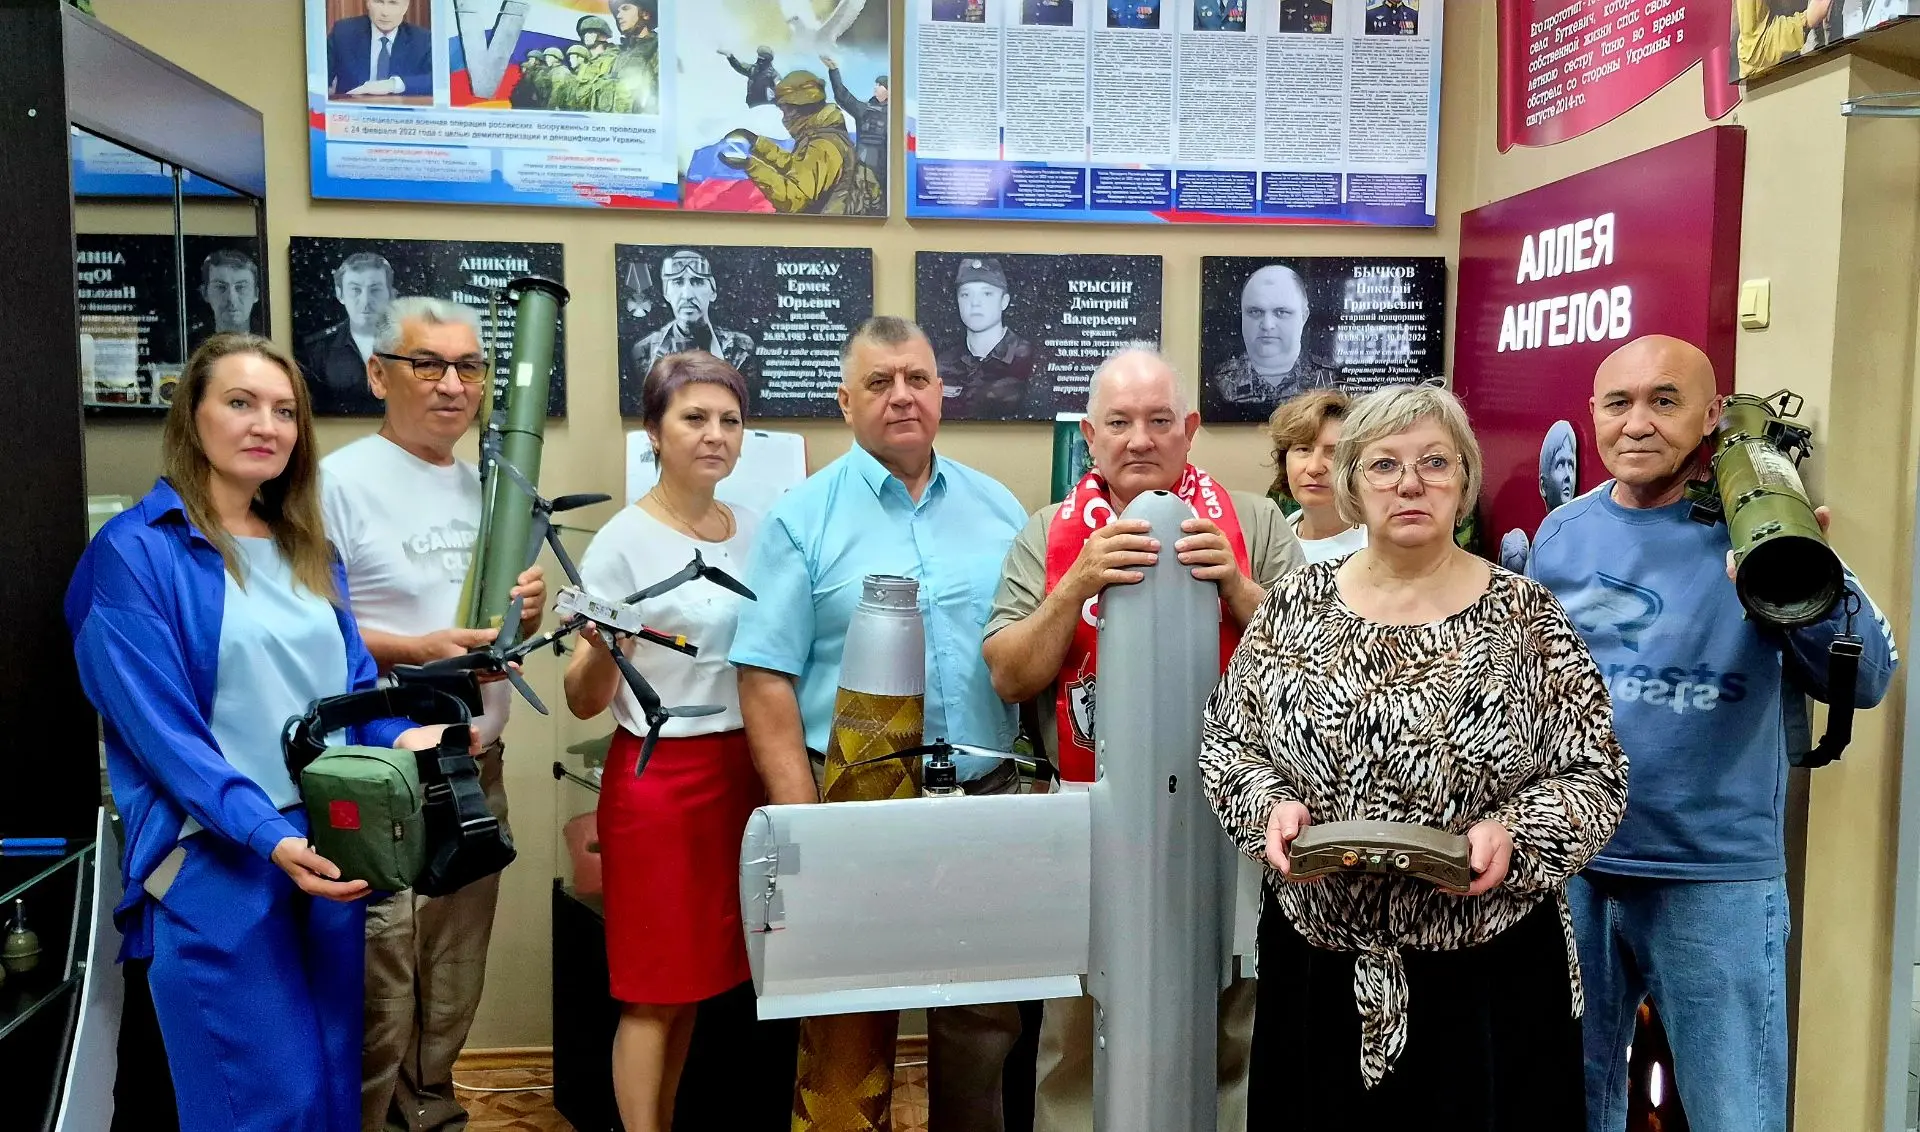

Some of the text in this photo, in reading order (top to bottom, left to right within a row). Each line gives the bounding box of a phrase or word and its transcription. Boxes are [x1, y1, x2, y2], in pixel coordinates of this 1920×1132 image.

[1530, 22, 1543, 37] Его
[1530, 36, 1548, 55] села
[1555, 12, 1596, 43] Буткевич,
[1528, 36, 1580, 73] собственной
[1583, 22, 1612, 46] жизни
[1616, 9, 1640, 30] спас
[1528, 7, 1685, 92] летнюю сестру Таню во время
[1527, 83, 1563, 109] обстрела
[1566, 78, 1577, 91] со
[1582, 58, 1620, 84] стороны
[1626, 35, 1671, 64] Украины
[1526, 106, 1556, 126] августе
[362, 117, 414, 125] специальная
[449, 120, 486, 128] операция
[536, 124, 590, 132] вооруженных
[610, 127, 656, 135] проводимая
[350, 126, 360, 134] 24
[362, 127, 398, 136] февраля
[399, 128, 416, 136] 2022
[472, 132, 540, 140] демилитаризации
[550, 134, 610, 143] денацификации
[1516, 212, 1615, 285] АЛЛЕЯ
[458, 257, 529, 272] АНИКИН
[776, 263, 840, 276] КОРЖАУ
[1353, 266, 1415, 278] БЫЧКОВ
[787, 280, 830, 294] Ермек
[1068, 280, 1133, 293] КРЫСИН
[1356, 282, 1411, 294] Николай
[777, 296, 841, 311] Юрьевич
[1070, 297, 1129, 311] Дмитрий
[1344, 298, 1423, 312] Григорьевич
[1062, 312, 1137, 328] Валерьевич
[1340, 313, 1425, 323] старший прапорщик
[1497, 285, 1632, 353] АНГЕЛОВ
[770, 322, 809, 332] старший
[756, 347, 782, 356] Погиб
[789, 348, 809, 356] ходе
[762, 370, 816, 378] территории
[1048, 363, 1073, 372] Погиб
[760, 389, 838, 401] Мужества (посмер
[1053, 386, 1089, 394] террито
